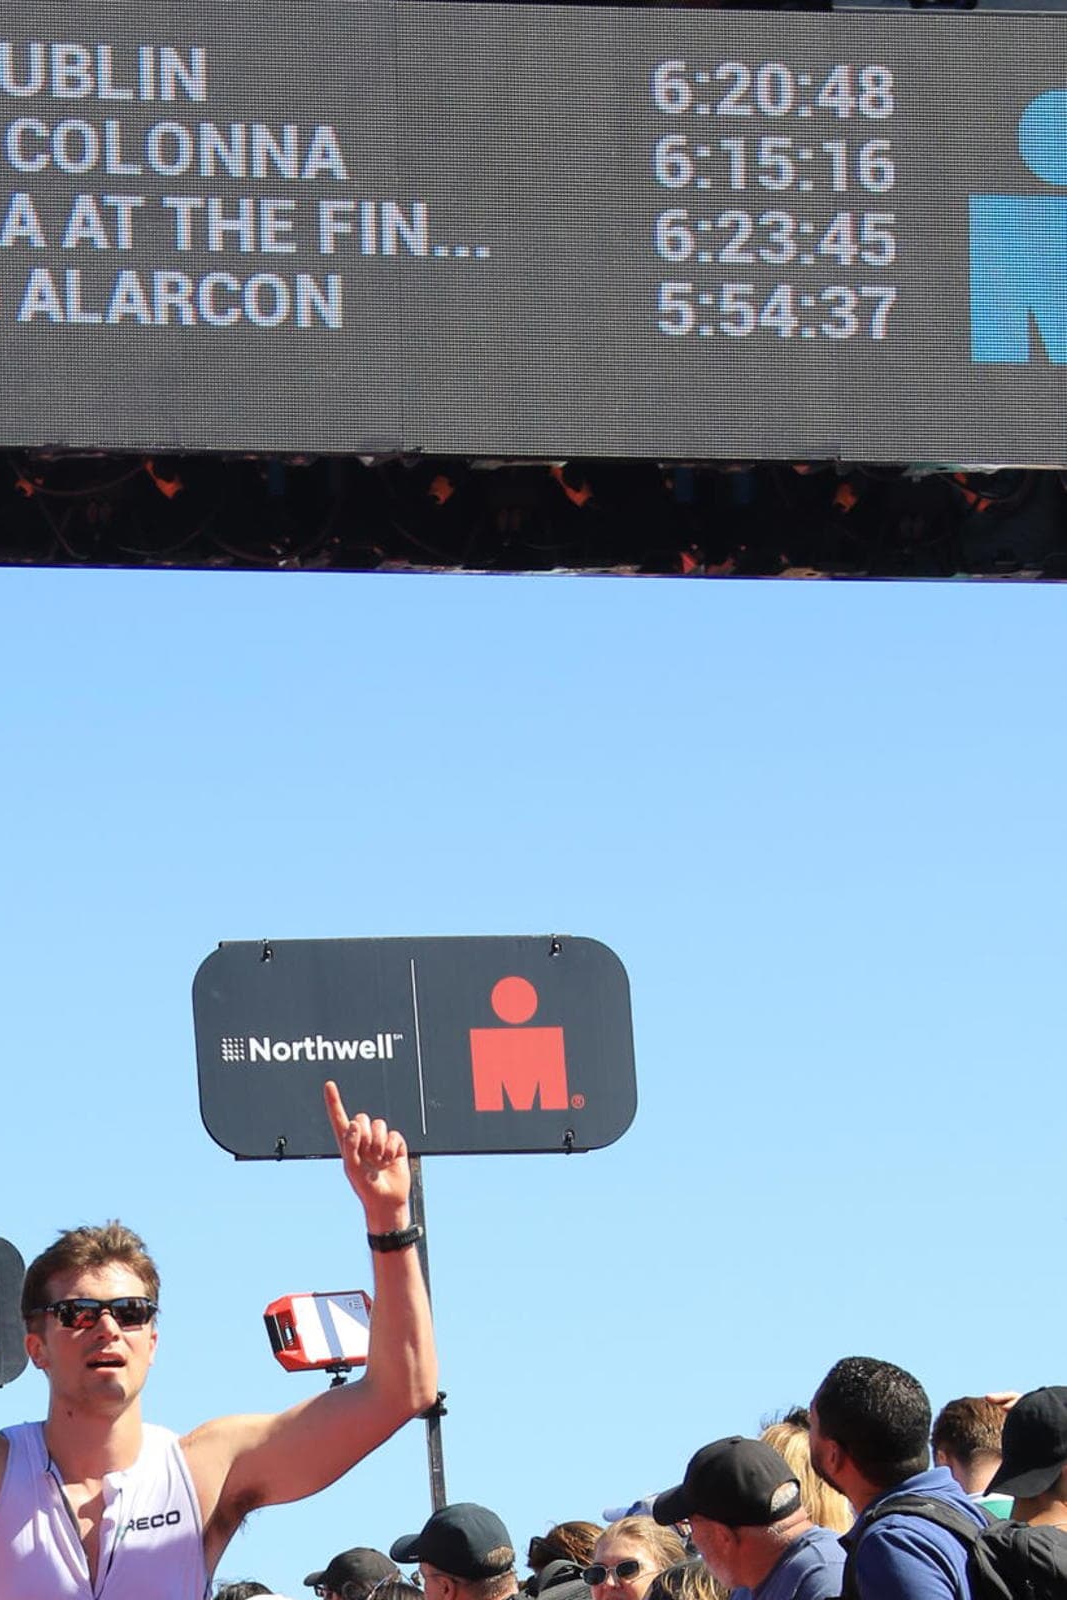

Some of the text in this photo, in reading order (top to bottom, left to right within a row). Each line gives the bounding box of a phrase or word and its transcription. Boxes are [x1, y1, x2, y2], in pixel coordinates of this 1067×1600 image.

[655, 61, 893, 118] 6:20:48
[7, 118, 347, 179] COLONNA
[656, 135, 894, 192] 6:15:16
[64, 195, 144, 249] AT
[164, 197, 296, 253] THE
[320, 201, 489, 257] FIN...
[657, 209, 895, 265] 6:23:45
[19, 269, 342, 328] ALARCON
[660, 282, 895, 339] 5:54:37
[248, 1033, 394, 1062] Northwell
